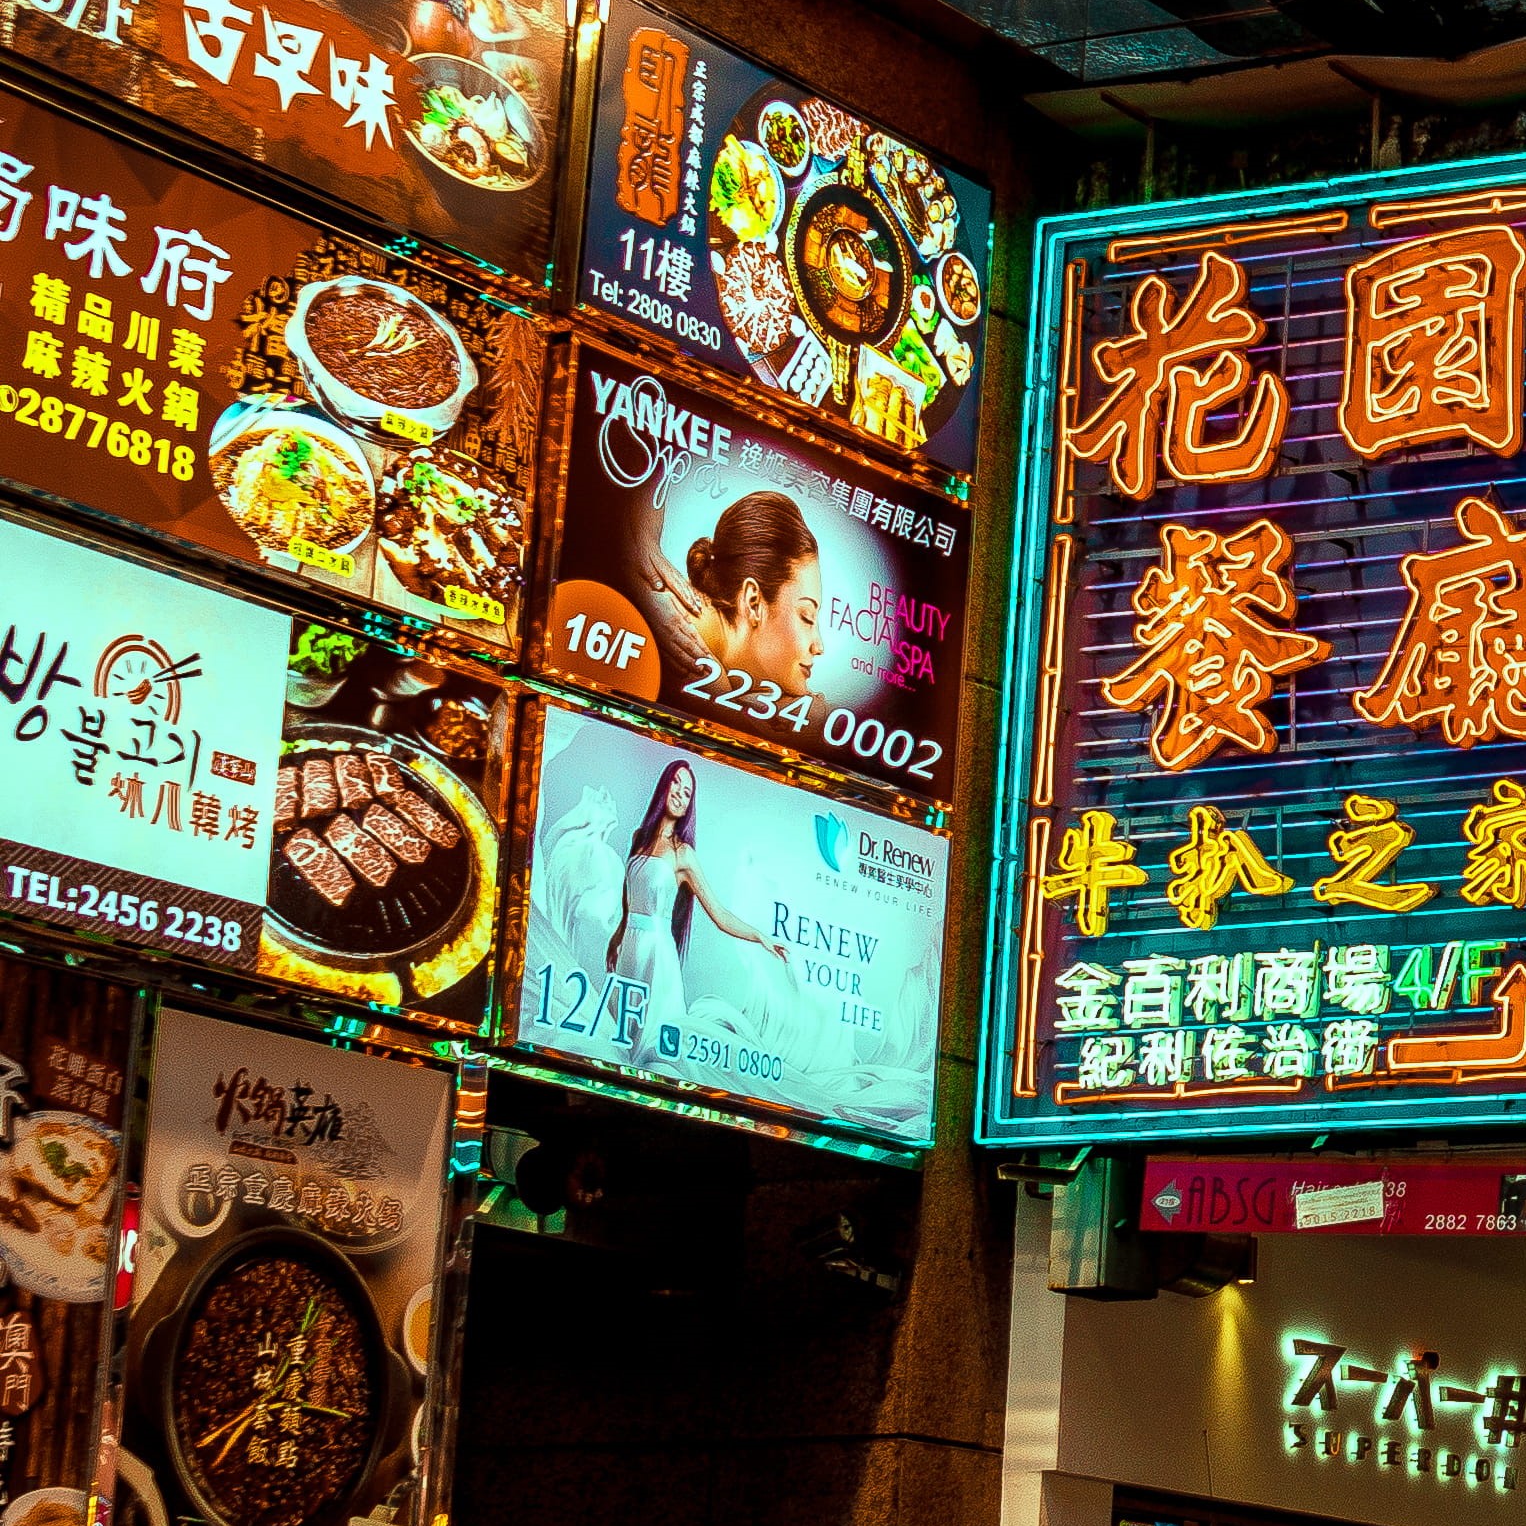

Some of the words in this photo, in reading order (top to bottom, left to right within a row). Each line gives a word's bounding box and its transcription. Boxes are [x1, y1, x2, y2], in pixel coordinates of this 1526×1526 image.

[618, 226, 695, 304] 11樓
[28, 271, 208, 379] 精品川菜
[590, 269, 624, 308] Tel:
[627, 292, 674, 330] 2808
[676, 311, 721, 351] 0830
[22, 330, 201, 432] 麻辣火鍋
[17, 384, 196, 482] 28776818
[590, 371, 732, 466] YANKEE
[564, 610, 646, 672] 16/F
[869, 580, 951, 642] BEAUTY
[851, 656, 875, 676] and
[683, 657, 811, 734] 2234
[823, 709, 944, 781] 0002
[858, 831, 879, 860] Dr.
[882, 839, 935, 878] Renew
[7, 865, 158, 933] TEL:2456
[164, 905, 242, 952] 2238
[816, 872, 858, 894] RENEW
[865, 888, 899, 906] YOUR
[906, 903, 934, 918] LIFE
[772, 901, 879, 966] RENEW
[535, 963, 650, 1048] 12/F
[804, 958, 863, 999] YOUR
[1054, 946, 1392, 1036] 金百利商場
[1393, 940, 1508, 1011] 4/F
[841, 1000, 883, 1033] LIFE
[686, 1034, 732, 1072] 2591
[737, 1044, 783, 1083] 0800
[1078, 1021, 1382, 1090] 紀利佐治街
[1424, 1212, 1466, 1231] 2882
[1475, 1212, 1518, 1232] 7863
